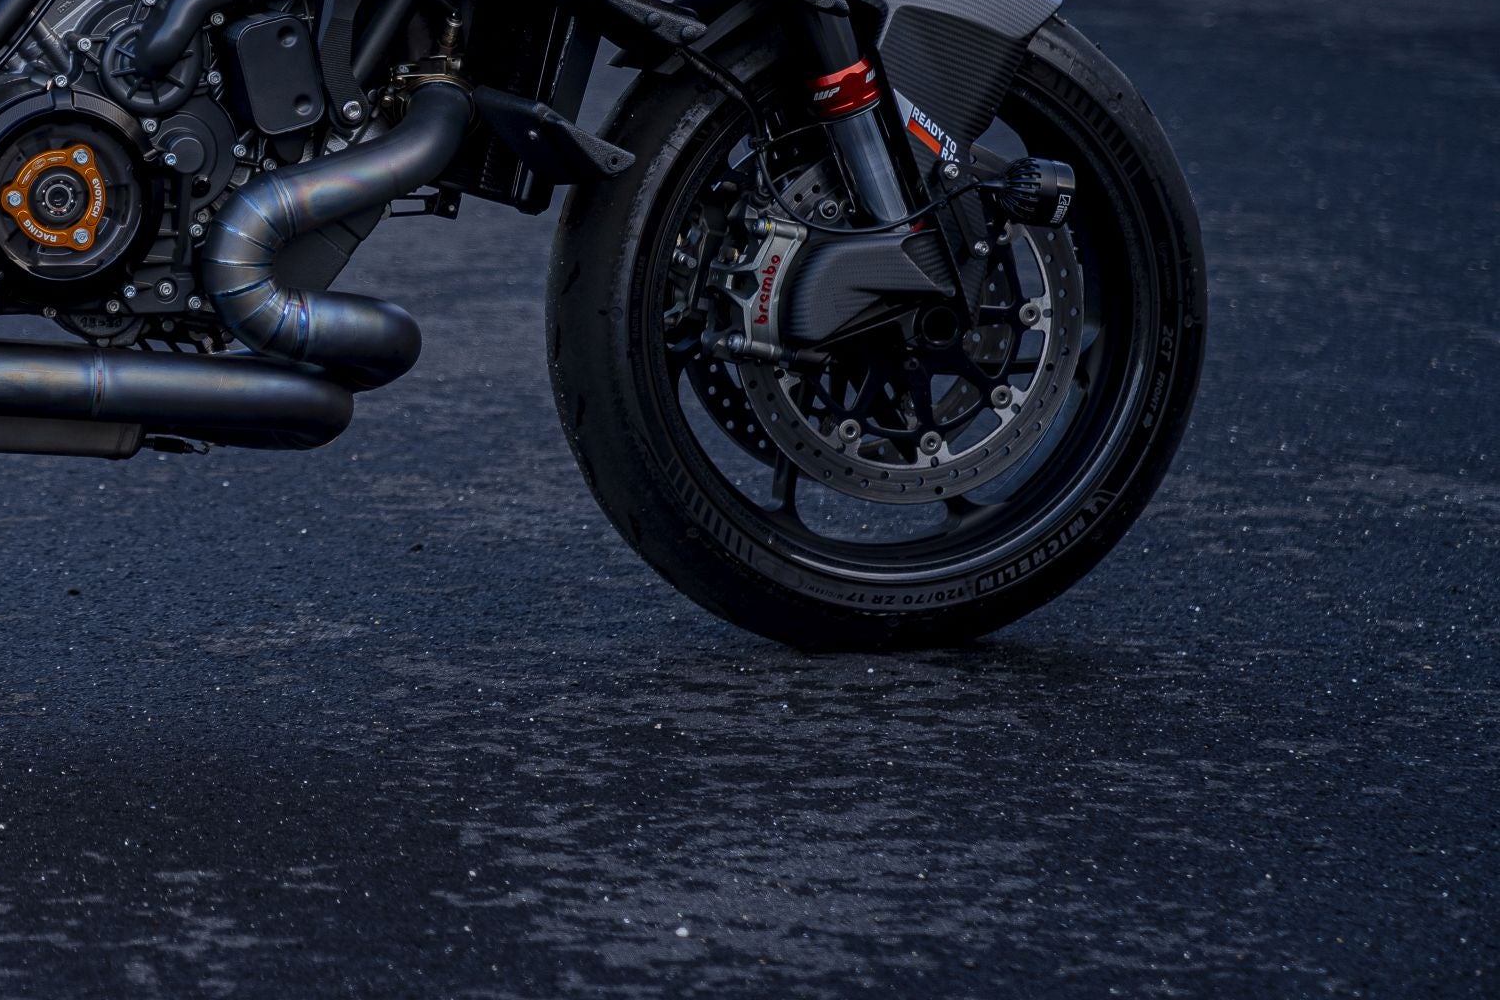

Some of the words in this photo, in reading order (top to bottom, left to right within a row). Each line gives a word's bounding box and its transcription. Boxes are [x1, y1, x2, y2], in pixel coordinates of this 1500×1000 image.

[814, 86, 841, 101] WP
[911, 106, 945, 143] READY
[945, 135, 957, 154] TO
[92, 178, 102, 217] EVOTECH
[23, 219, 57, 242] RACING
[754, 255, 780, 324] brembo
[1161, 324, 1174, 363] 2CT
[978, 514, 1086, 590] MICHELIN
[847, 592, 866, 604] 17
[872, 594, 895, 605] ZR
[903, 588, 964, 605] 120/70
